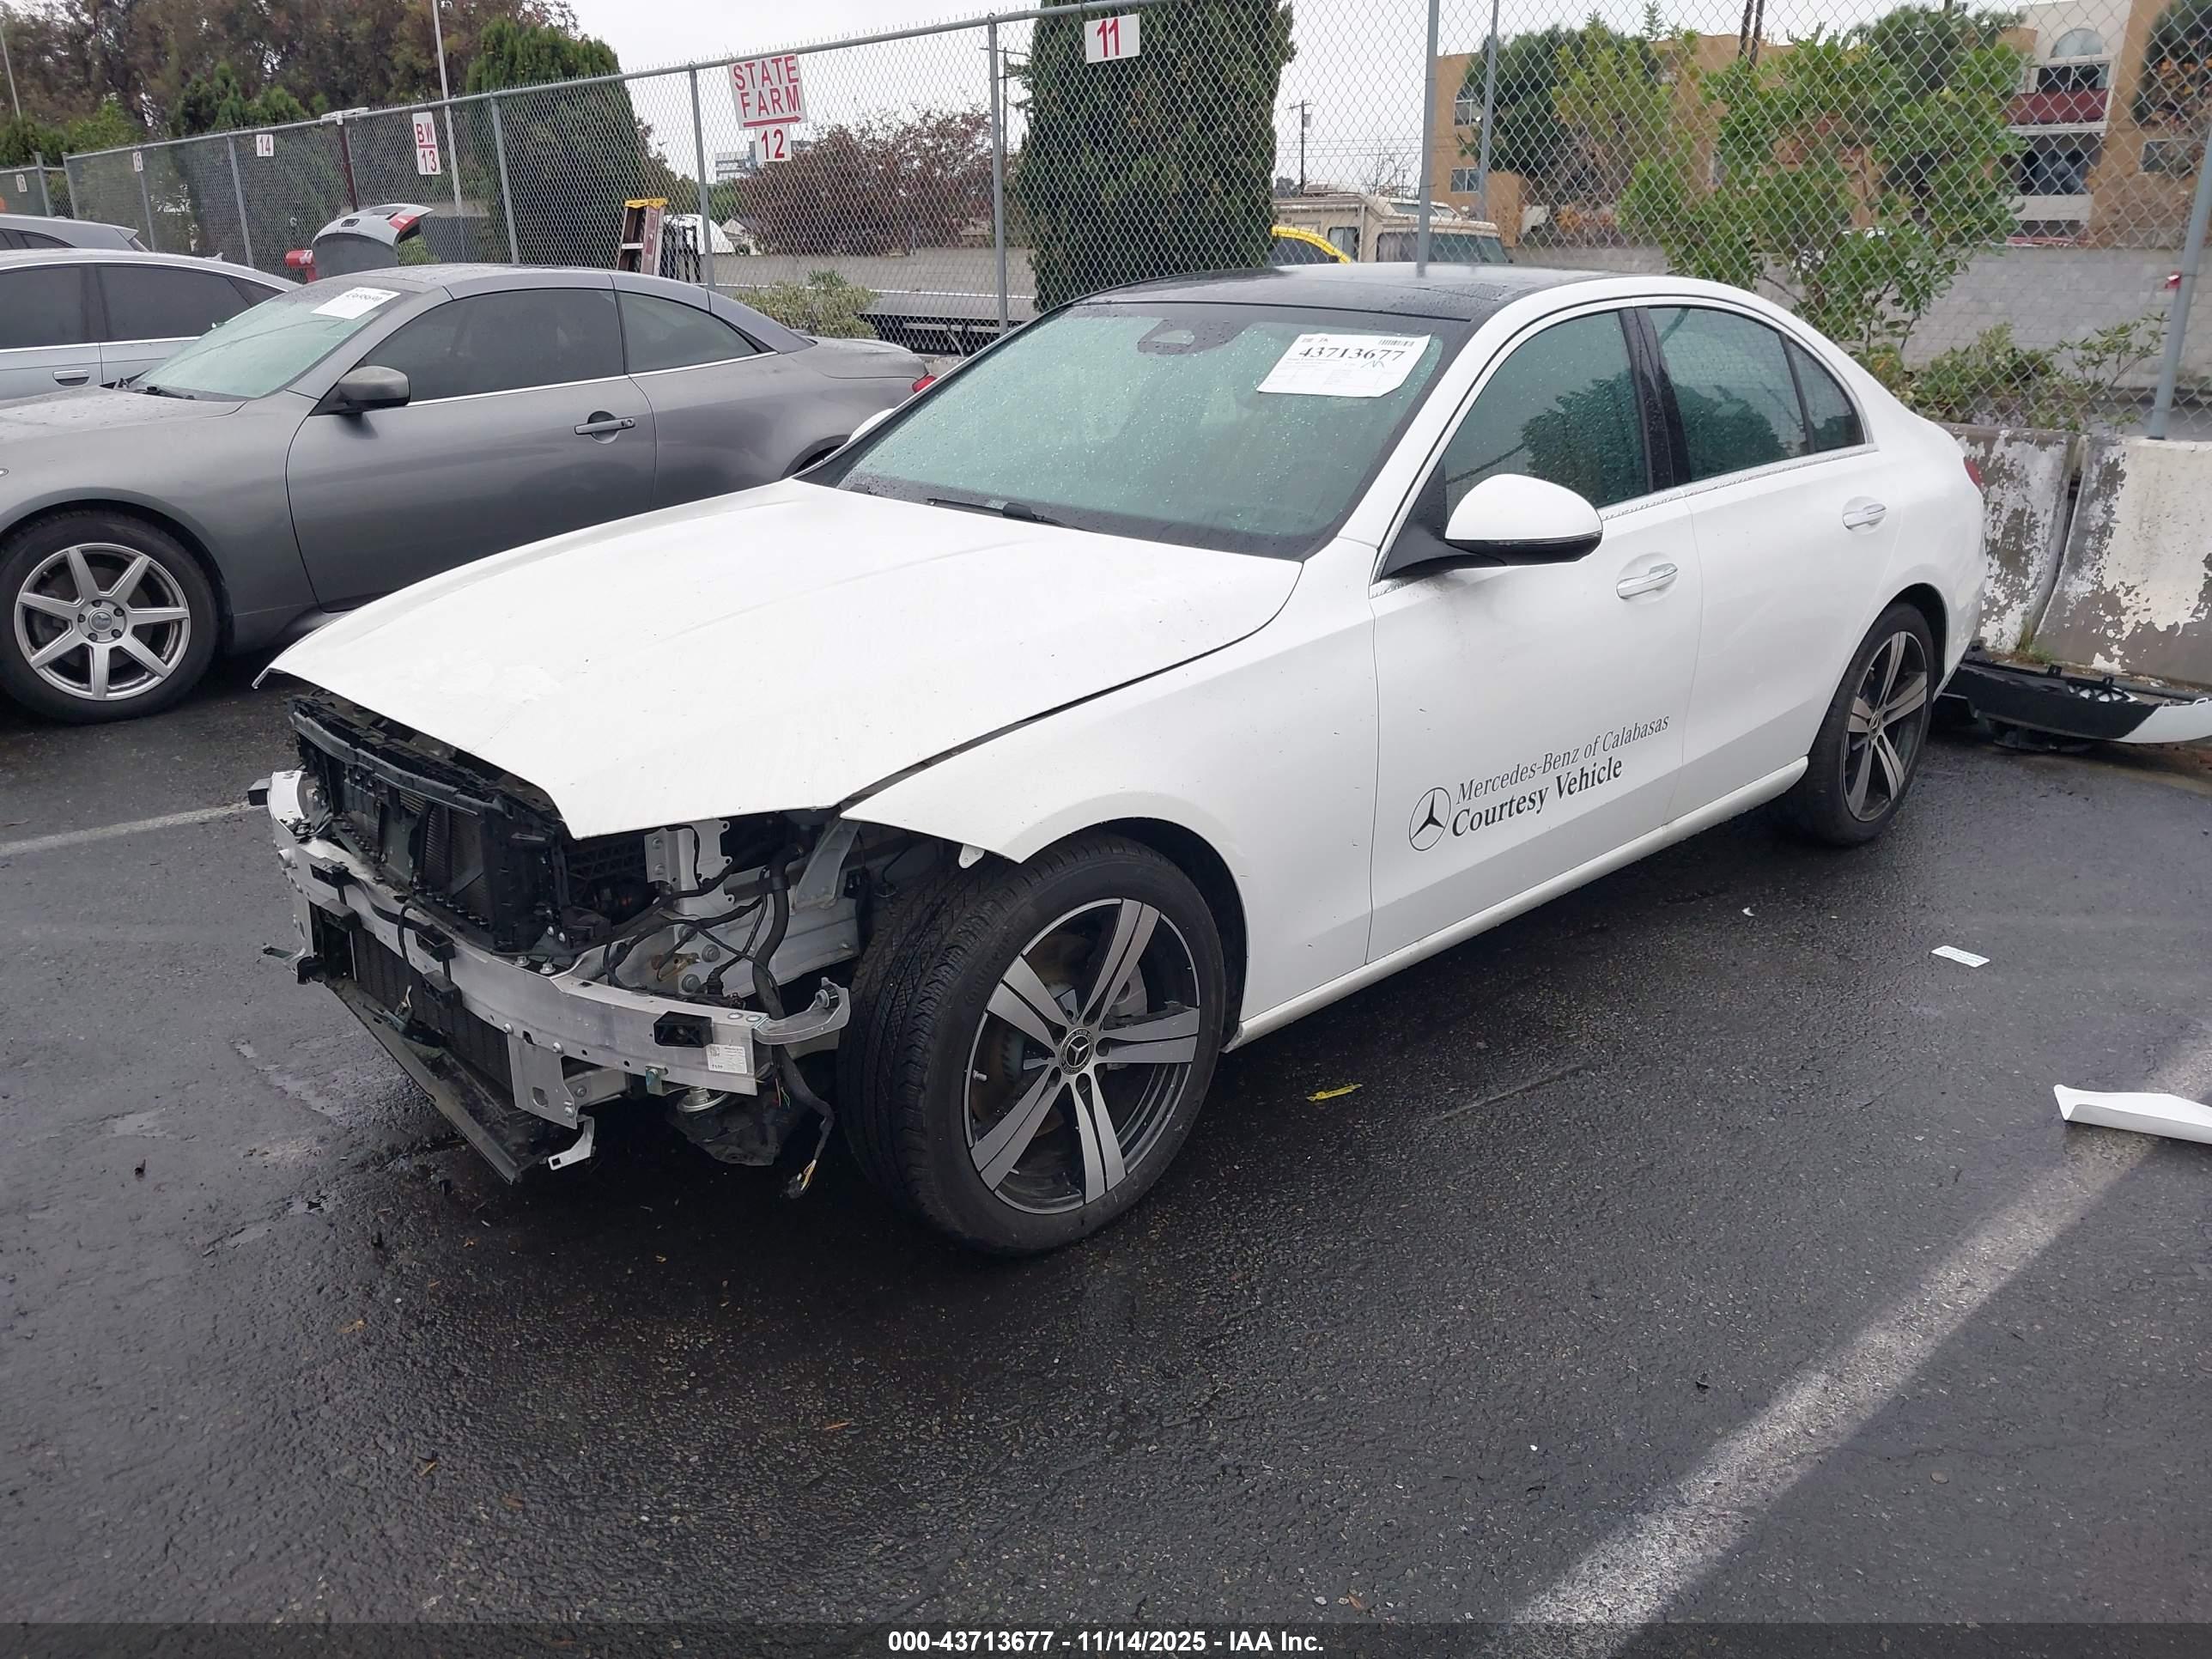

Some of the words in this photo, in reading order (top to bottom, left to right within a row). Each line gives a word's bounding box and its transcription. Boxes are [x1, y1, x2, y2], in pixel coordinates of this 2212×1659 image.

[1097, 18, 1120, 58] 11
[733, 56, 799, 90] STATE
[740, 85, 801, 118] FARM
[259, 136, 271, 155] 14
[416, 123, 434, 143] BW
[761, 129, 785, 160] 12
[422, 150, 437, 173] 13
[1298, 347, 1406, 362] 43713677
[1455, 746, 1580, 805] Mercedes-Benz
[1583, 735, 1601, 759] of
[1602, 715, 1670, 752] Calabasas
[1452, 787, 1549, 838] Courtesy
[1556, 756, 1622, 799] Vehicle
